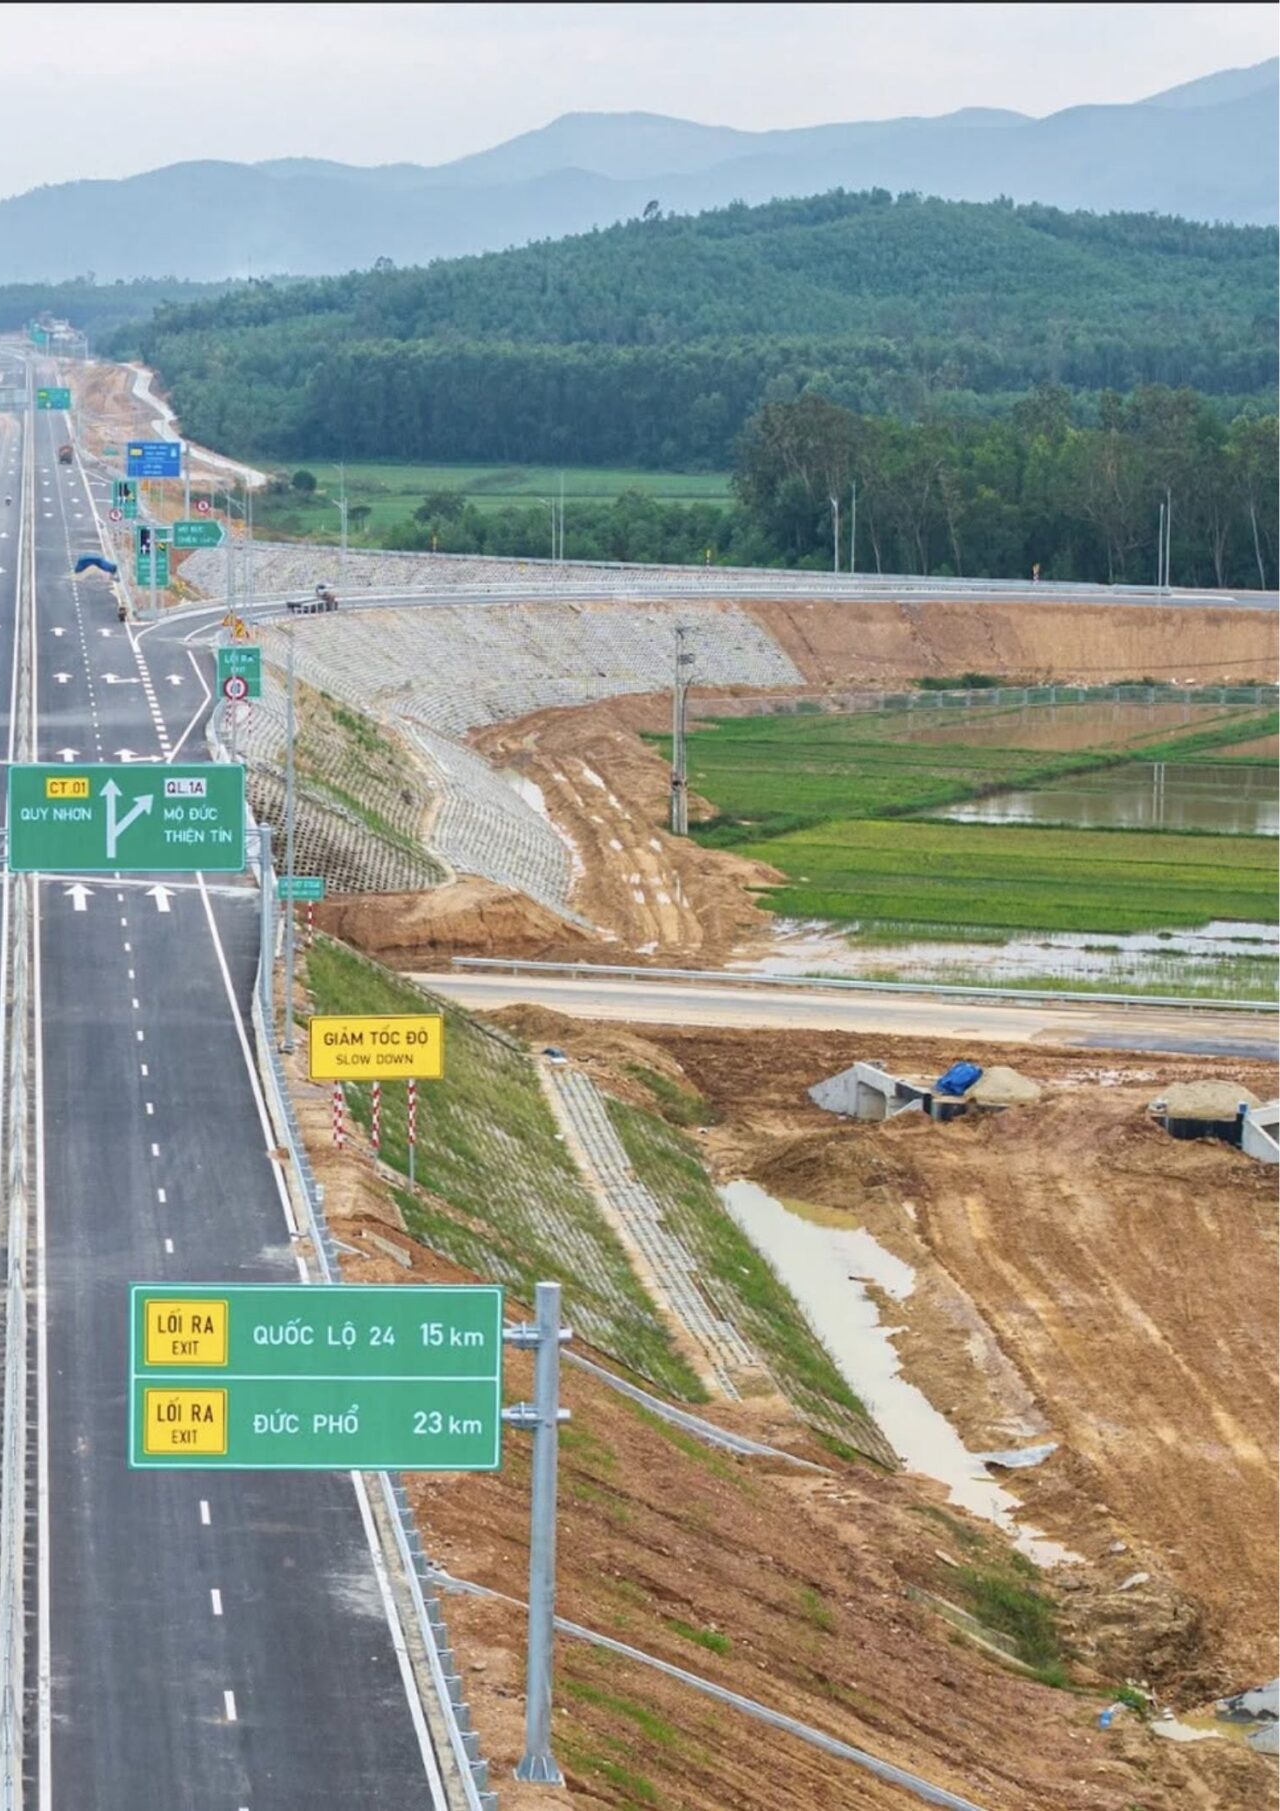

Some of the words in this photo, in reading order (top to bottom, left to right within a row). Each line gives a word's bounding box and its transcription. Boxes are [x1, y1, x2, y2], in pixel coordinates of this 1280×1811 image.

[20, 807, 49, 821] QUY
[189, 804, 218, 821] ĐỨC
[164, 826, 205, 846] THIỆN
[210, 826, 233, 843] TÍN
[323, 1026, 364, 1046] GIẢM
[370, 1024, 400, 1045] TỐC
[406, 1026, 429, 1048] ĐỘ
[336, 1054, 370, 1065] SLOW
[376, 1053, 414, 1065] DOWN
[157, 1308, 183, 1334] LỐI
[191, 1315, 214, 1334] RA
[253, 1318, 314, 1346] QUỐC
[328, 1322, 356, 1352] LỘ
[369, 1326, 395, 1346] 24
[420, 1324, 443, 1347] 15
[450, 1328, 484, 1347] km
[172, 1340, 200, 1356] EXIT
[156, 1397, 182, 1422] LỐI
[191, 1403, 214, 1422] RA
[253, 1409, 299, 1434] ĐỨC
[313, 1404, 359, 1434] PHỔ
[413, 1411, 442, 1434] 23
[449, 1416, 483, 1434] km
[171, 1429, 198, 1444] EXIT
